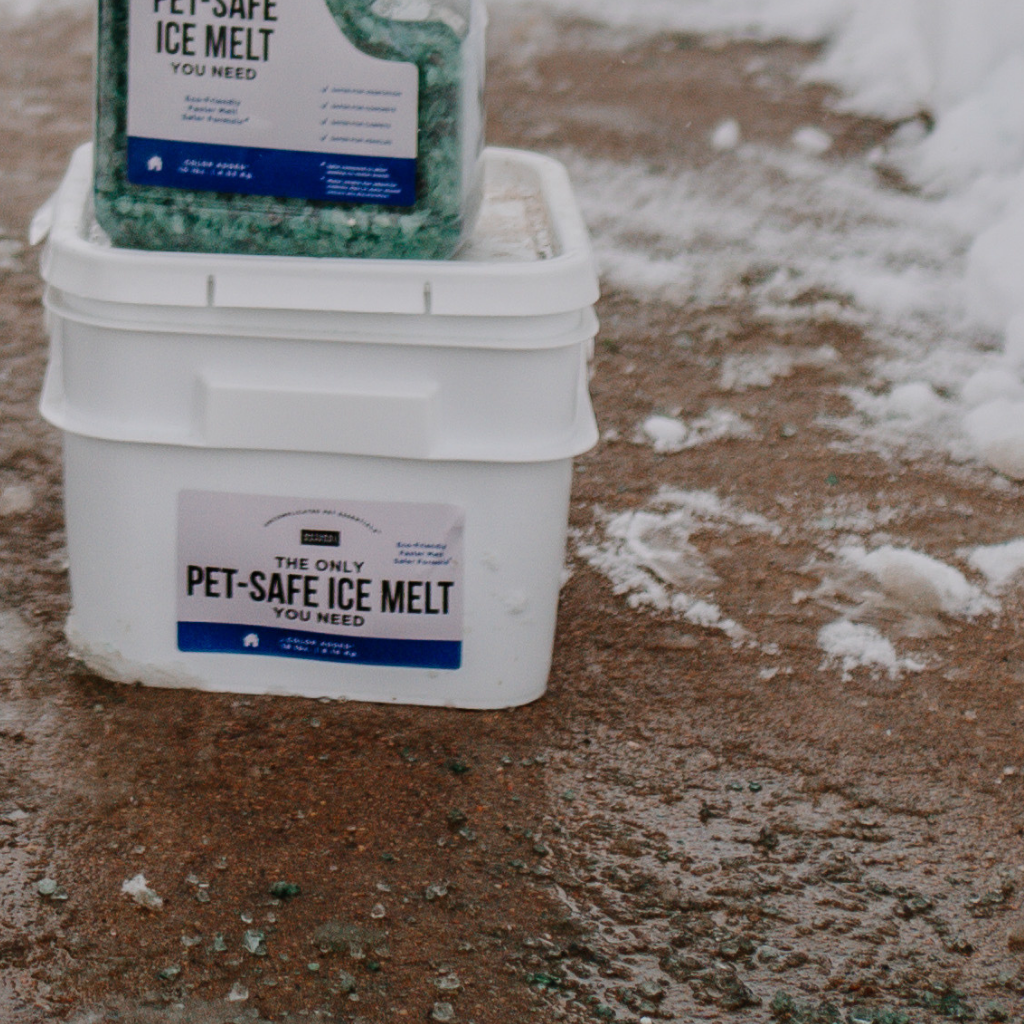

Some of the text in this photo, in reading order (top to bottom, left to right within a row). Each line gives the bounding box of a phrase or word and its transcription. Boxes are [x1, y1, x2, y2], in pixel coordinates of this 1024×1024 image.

[156, 20, 275, 61] ICE MELT
[171, 61, 257, 81] YOU NEED
[275, 556, 365, 574] THE ONLY
[186, 564, 455, 615] PET-SAFE ICE MELT
[272, 606, 366, 627] YOU NEED
